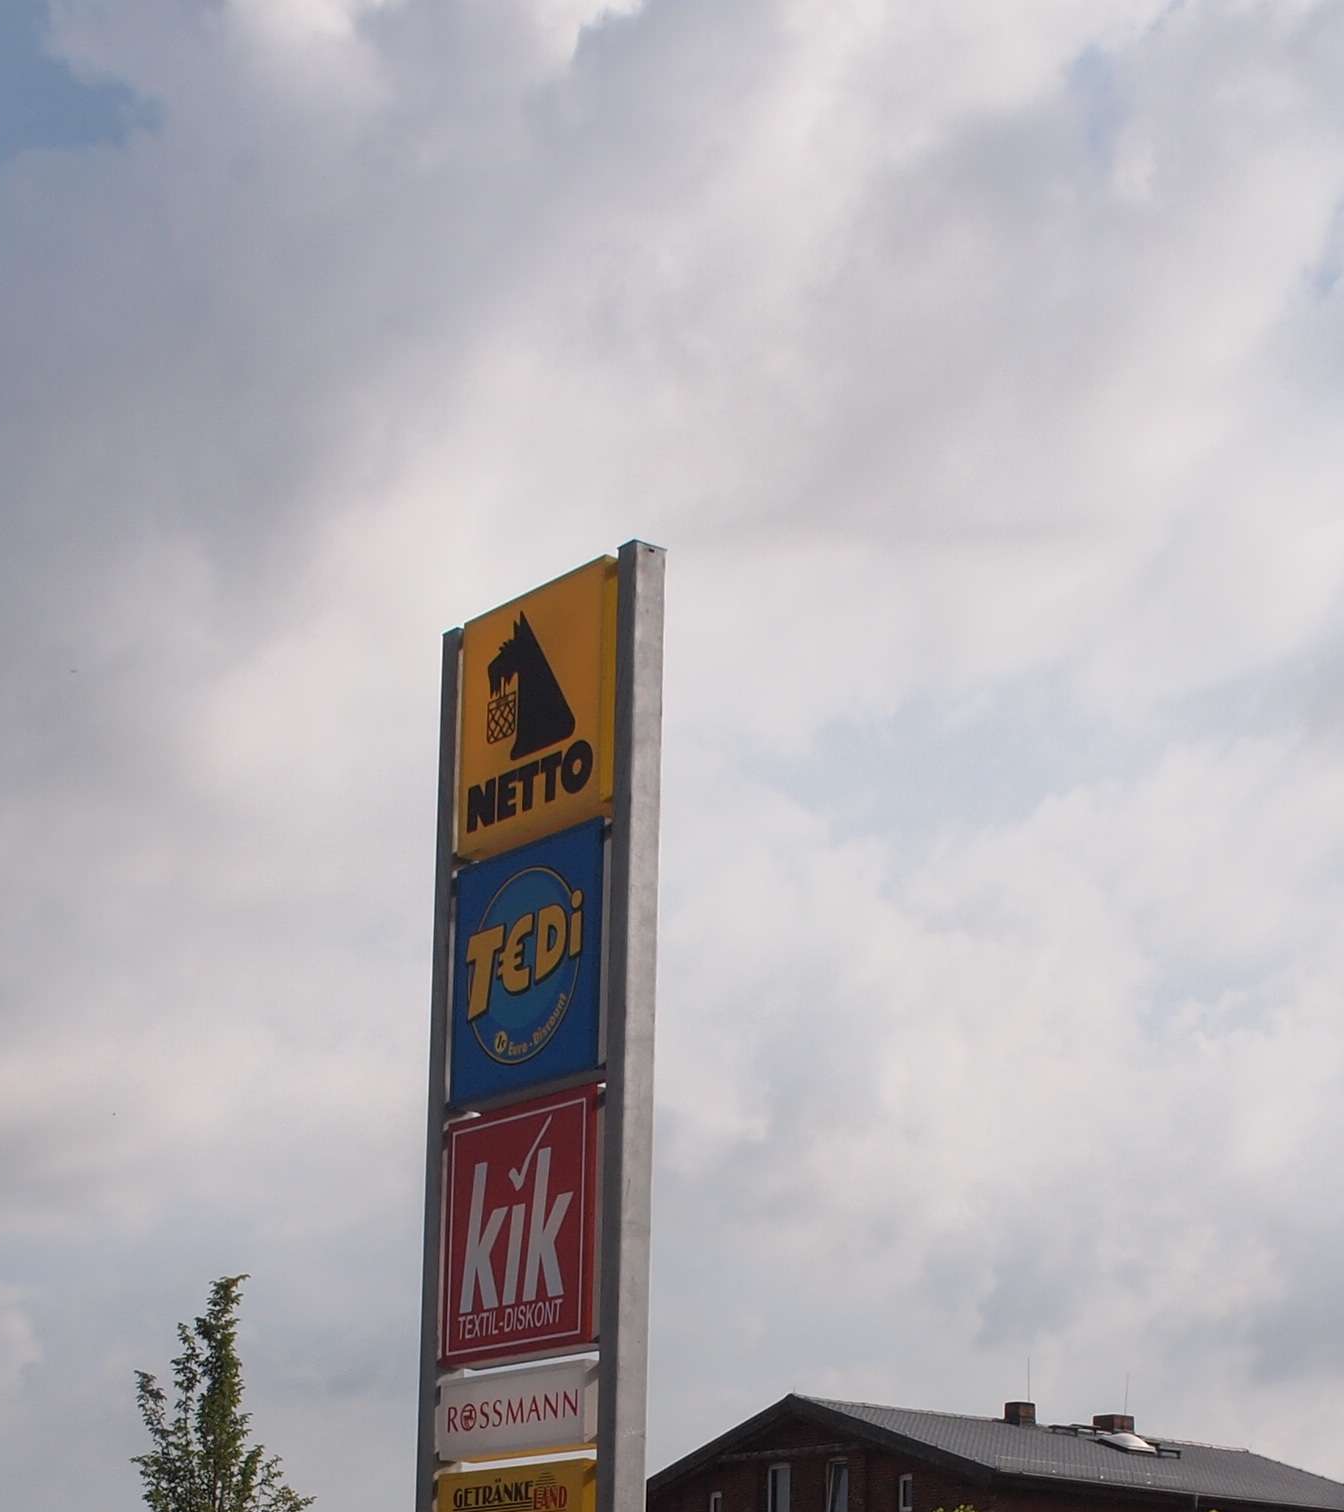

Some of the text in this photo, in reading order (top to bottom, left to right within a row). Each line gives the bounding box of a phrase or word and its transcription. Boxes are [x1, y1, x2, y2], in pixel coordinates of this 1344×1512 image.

[466, 739, 594, 833] NETTO
[458, 1298, 564, 1341] TEXTIL-DISKONT
[447, 1389, 579, 1434] ROSSMANN
